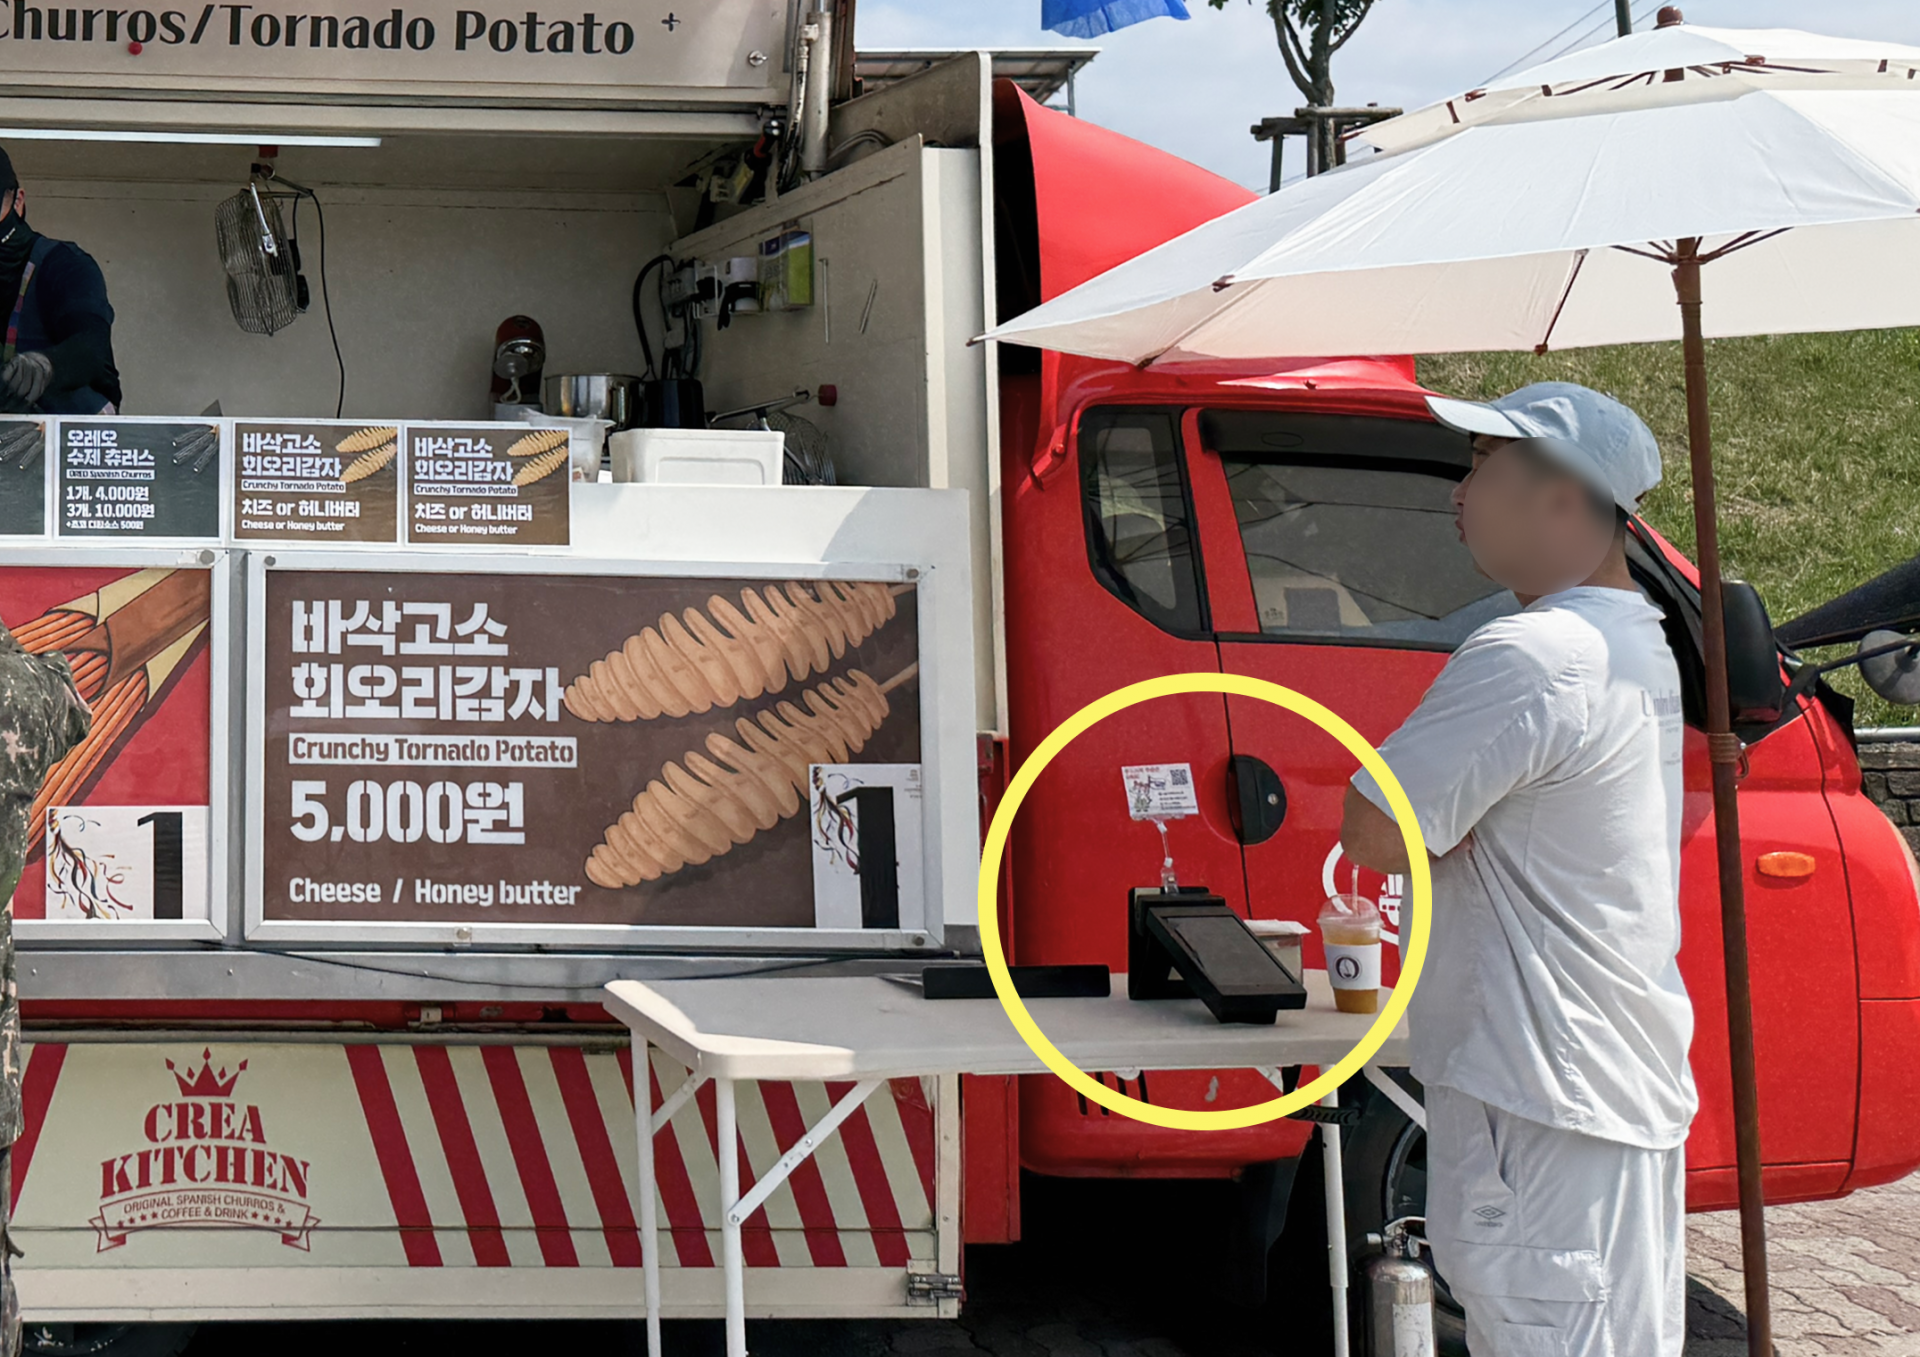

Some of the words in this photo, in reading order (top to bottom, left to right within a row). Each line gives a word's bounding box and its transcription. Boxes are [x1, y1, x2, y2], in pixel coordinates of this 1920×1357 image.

[455, 9, 635, 55] Potato
[67, 430, 118, 447] 오레오
[243, 432, 322, 454] 바삭고소
[414, 437, 493, 458] 바삭고소
[67, 448, 101, 466] 수제
[104, 448, 155, 466] 츄러스
[241, 455, 342, 478] 회오리감자
[414, 459, 514, 481] 회오리감자
[242, 480, 278, 490] Crunchy
[280, 481, 315, 490] Tornado
[316, 482, 345, 491] Potato
[415, 484, 451, 495] Crunchy
[452, 485, 487, 494] Tornado
[488, 487, 517, 495] Potato
[241, 498, 273, 515] 치즈
[276, 503, 295, 516] or
[298, 500, 360, 518] 허니버터
[414, 503, 446, 519] 치즈
[448, 507, 469, 520] or
[471, 504, 533, 521] 허니버터
[241, 519, 274, 529] Cheese
[286, 521, 315, 531] Honey
[316, 522, 345, 531] butter
[415, 523, 448, 533] Cheese
[460, 525, 488, 535] Honey
[488, 526, 518, 535] butter
[292, 600, 509, 656] 바삭고소
[289, 662, 565, 722] 회오리감자
[292, 737, 389, 761] Crunchy
[394, 738, 491, 761] Tornado
[495, 740, 574, 763] Potato
[290, 780, 526, 844] 5,000원
[289, 877, 381, 902] Cheese
[392, 878, 404, 903] /
[415, 879, 494, 907] Honey
[499, 880, 581, 905] butter
[143, 1101, 267, 1144] CREA
[100, 1144, 310, 1200] KITCHEN
[123, 1196, 174, 1215] ORIGINAL
[176, 1194, 222, 1206] SPANISH
[223, 1195, 275, 1212] CHURROS
[277, 1203, 286, 1214] &
[161, 1207, 201, 1220] COFFEE
[203, 1206, 212, 1217] &
[214, 1207, 249, 1219] DRINK
